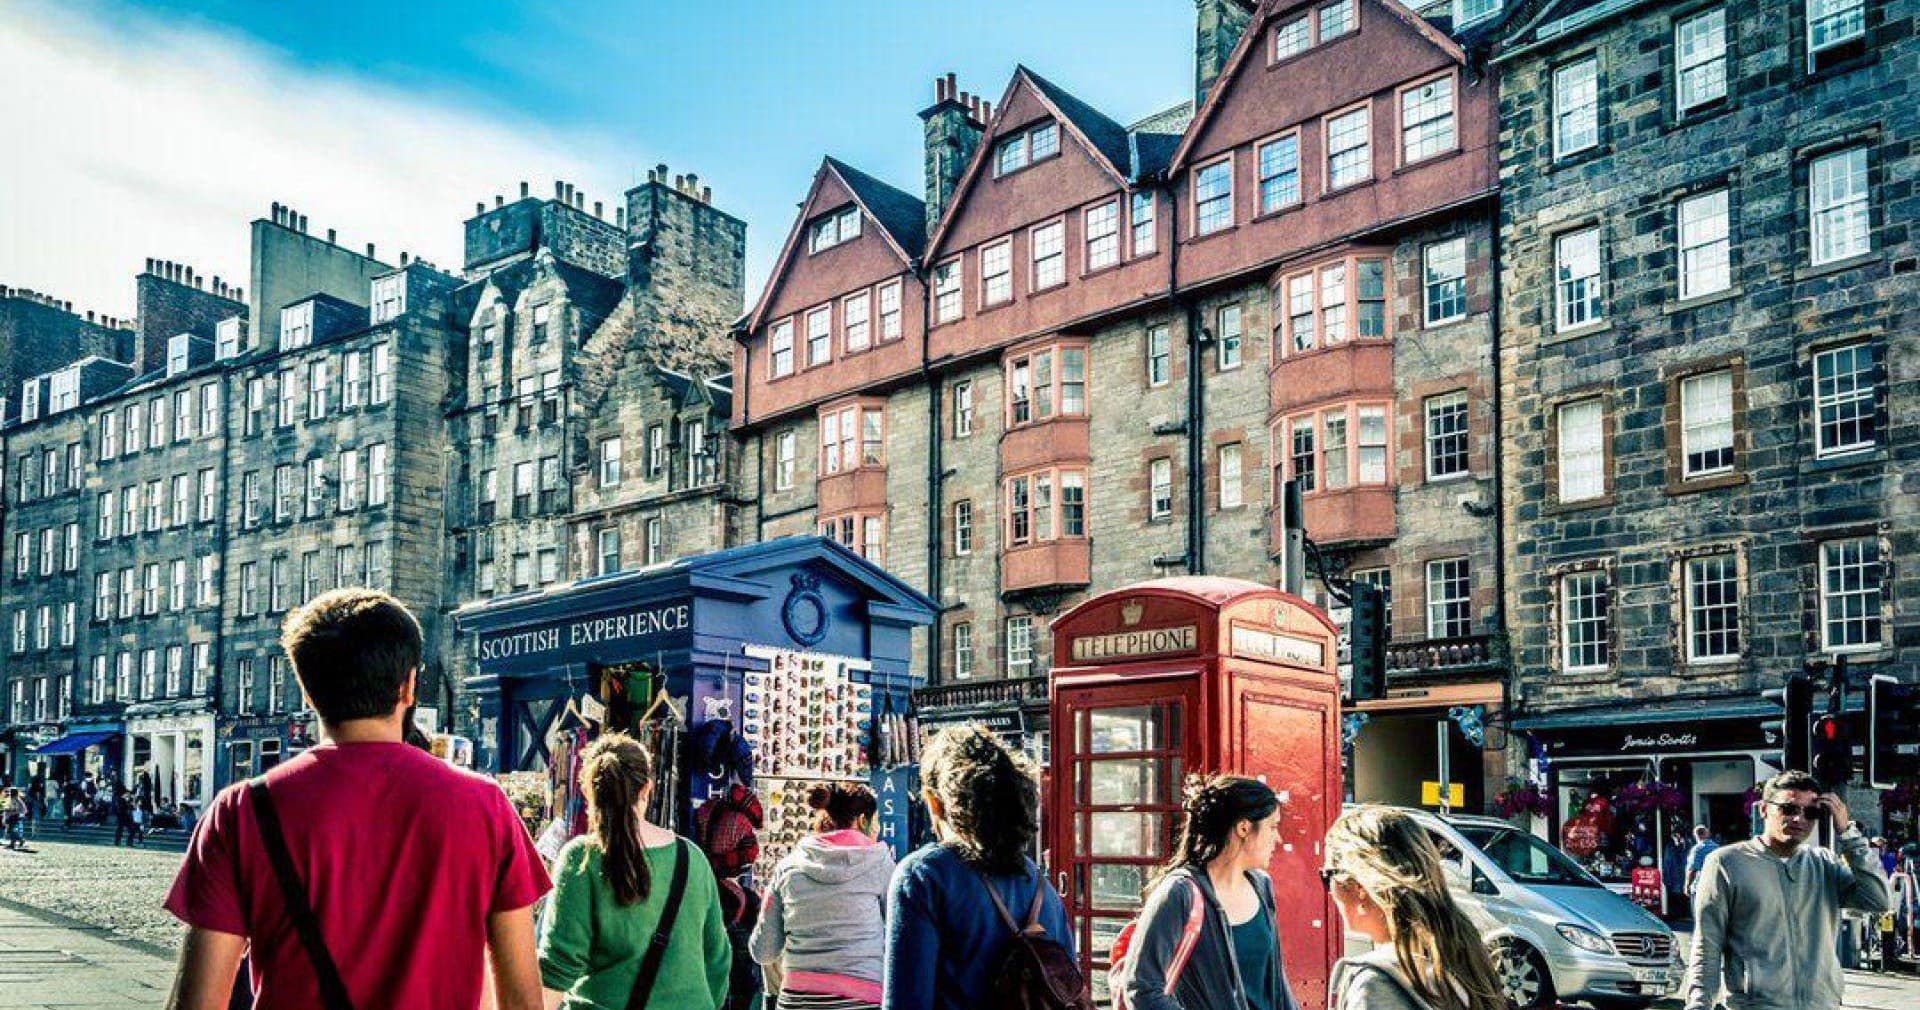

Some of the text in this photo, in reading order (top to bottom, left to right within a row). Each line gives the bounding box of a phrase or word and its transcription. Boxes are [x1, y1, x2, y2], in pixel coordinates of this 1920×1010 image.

[482, 605, 689, 660] SCOTTISH EXPERIENCE
[1078, 628, 1193, 658] TELEPHONE
